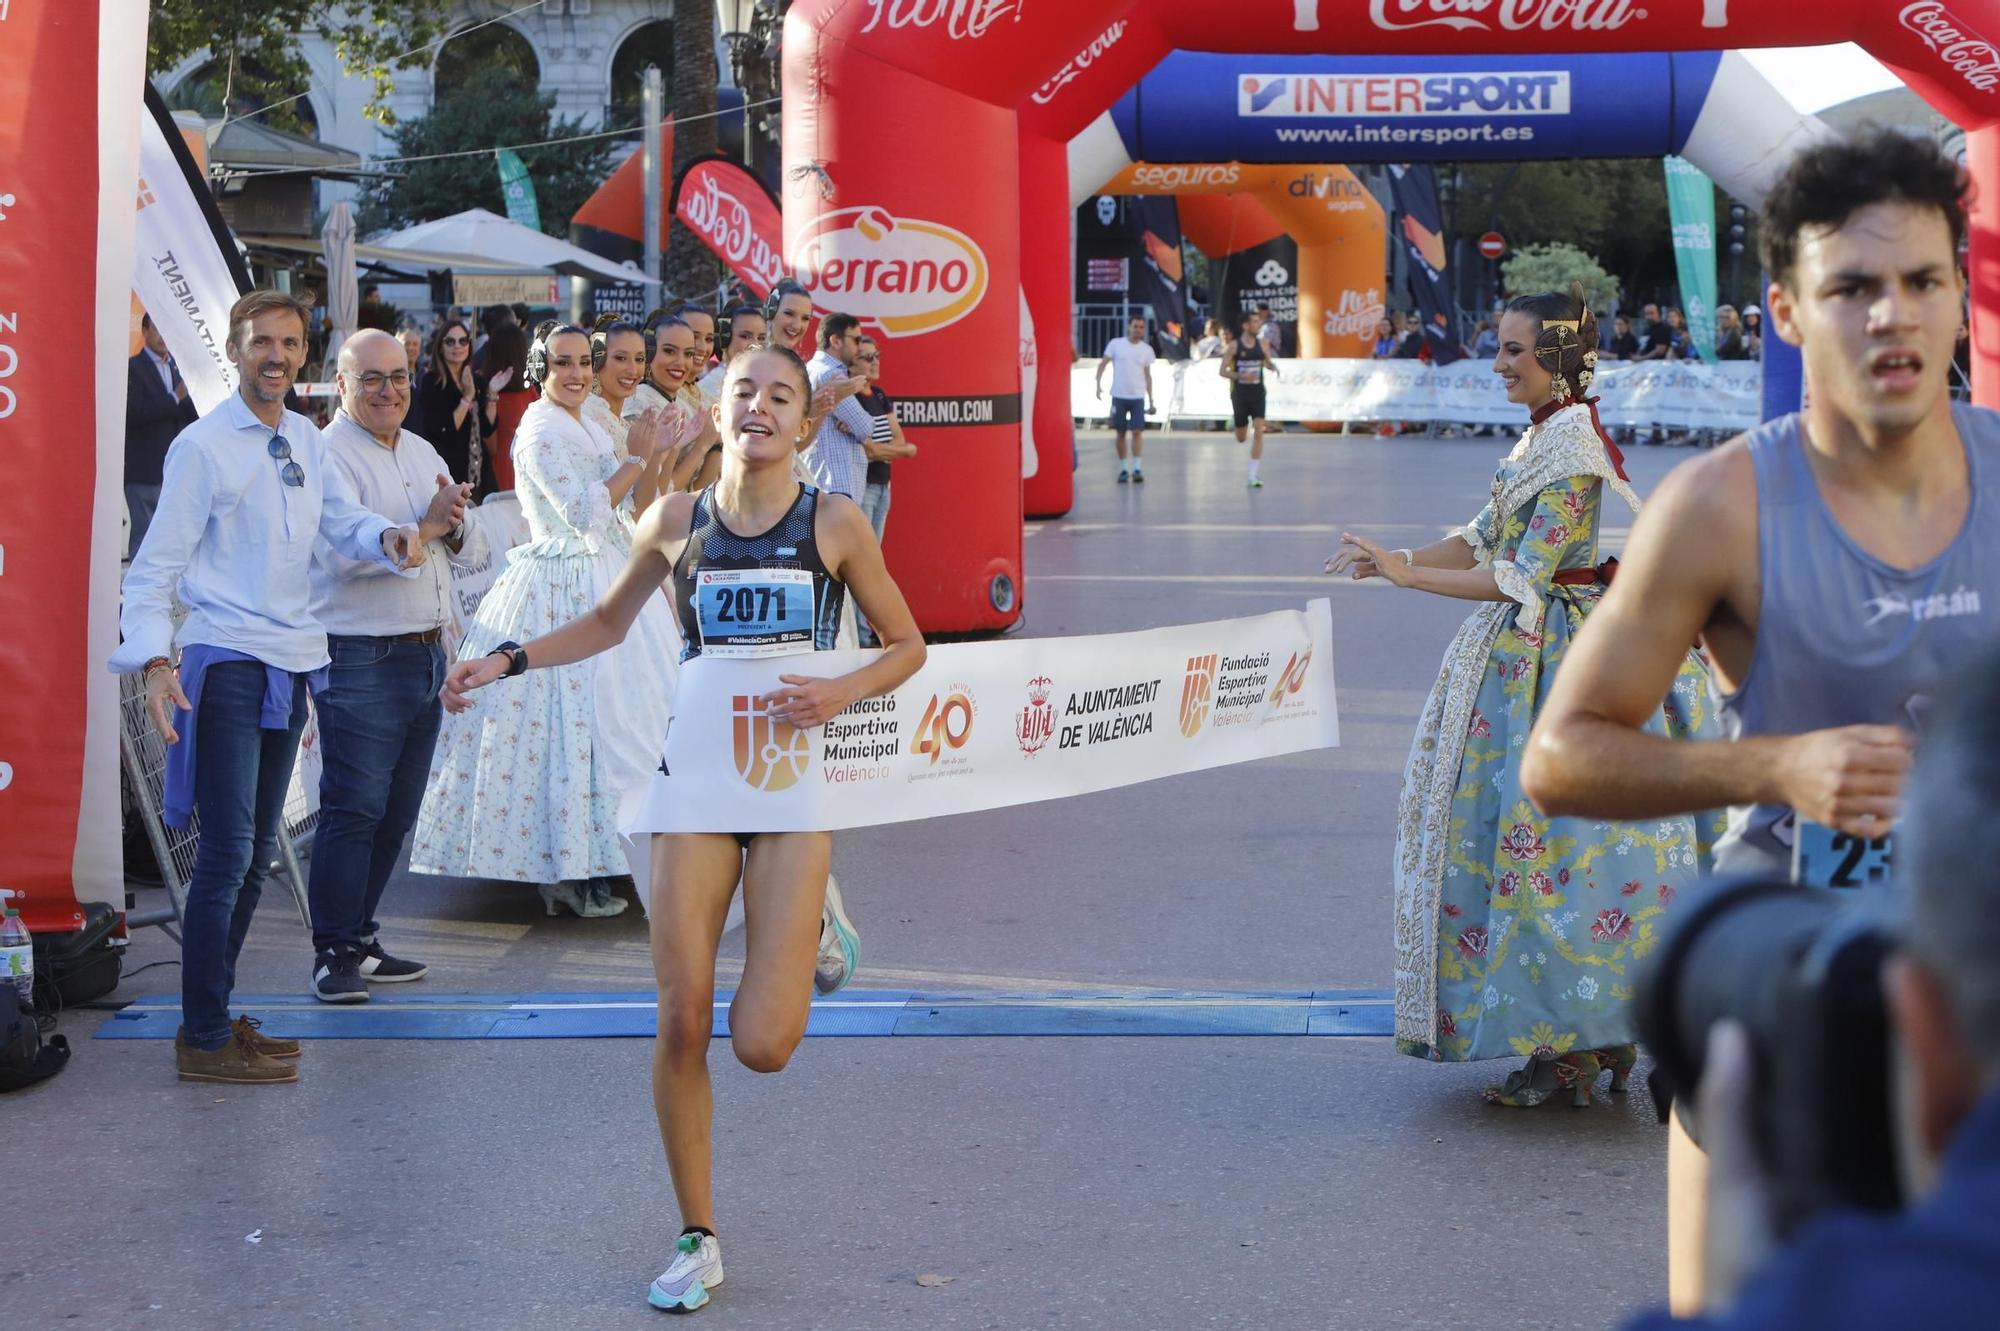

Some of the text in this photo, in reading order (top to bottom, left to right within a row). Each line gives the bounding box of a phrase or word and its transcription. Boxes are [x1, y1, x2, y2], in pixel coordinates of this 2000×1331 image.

[1294, 75, 1558, 113] INTERSPORT
[1276, 124, 1534, 145] www.intersport.es
[1131, 165, 1240, 189] seguros
[1289, 173, 1361, 198] divina
[802, 244, 968, 294] Serrano
[594, 288, 644, 299] FUNDAC
[596, 299, 645, 313] TRINID
[893, 400, 993, 423] ERRANO.COM
[716, 587, 786, 623] 2071
[1220, 652, 1270, 672] Fundació
[1218, 672, 1268, 693] Esportiva
[839, 695, 896, 715] ndació
[1065, 679, 1161, 716] AJUNTAMENT
[1216, 689, 1265, 709] Municipal
[823, 718, 898, 742] Esportiva
[910, 693, 974, 766] 40
[1059, 712, 1153, 749] DE VALÈNCIA
[1213, 710, 1254, 728] València
[824, 738, 899, 762] Municipal
[824, 763, 890, 784] València
